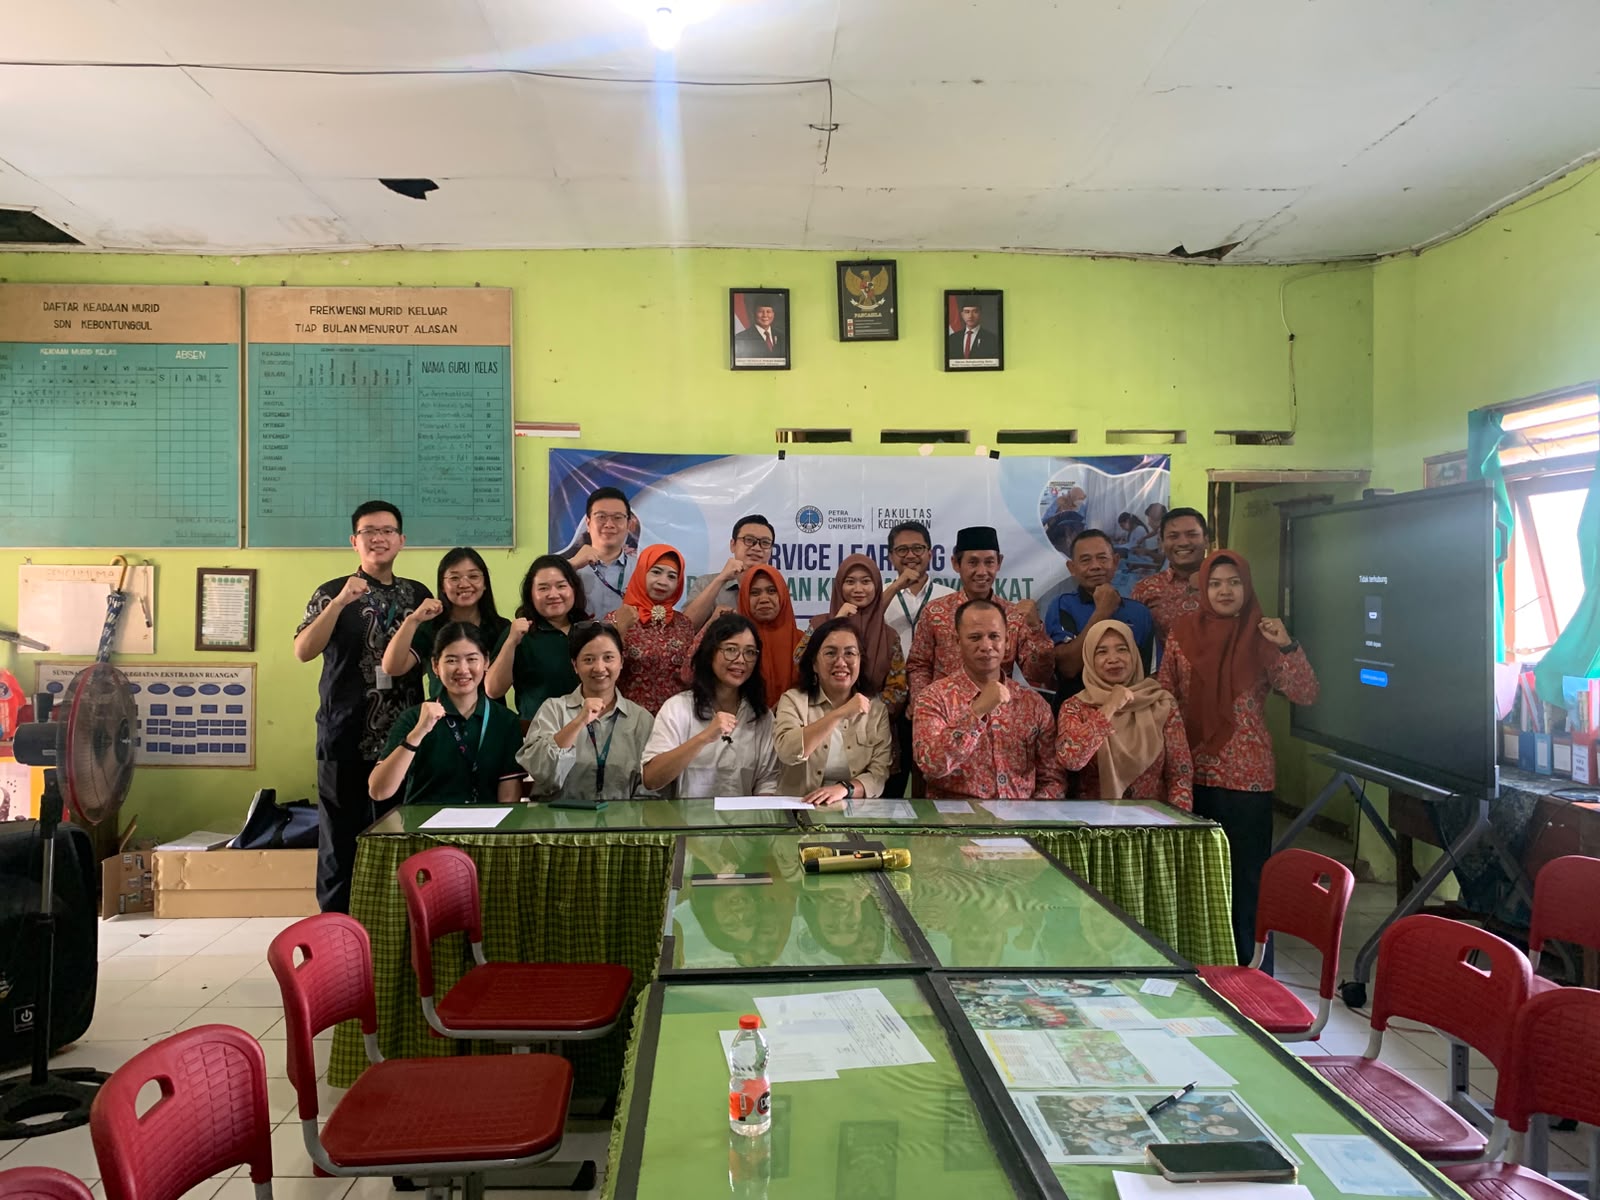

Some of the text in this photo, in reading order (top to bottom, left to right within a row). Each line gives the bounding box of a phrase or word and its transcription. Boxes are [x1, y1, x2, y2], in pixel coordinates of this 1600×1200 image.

[43, 301, 160, 313] DAFTAR KEADAAN MURID
[309, 305, 448, 316] FREKWENSI MURID KELUAR
[53, 319, 153, 331] SDN KEBONTUNGGUL
[295, 323, 458, 334] TIAP BULAN MENURUT ALASAN
[175, 350, 207, 360] ABSEN
[421, 361, 445, 374] NAMA
[448, 361, 470, 374] GURU
[474, 361, 498, 374] KELAS
[878, 508, 932, 519] FAKULTAS
[768, 543, 832, 571] RVICE
